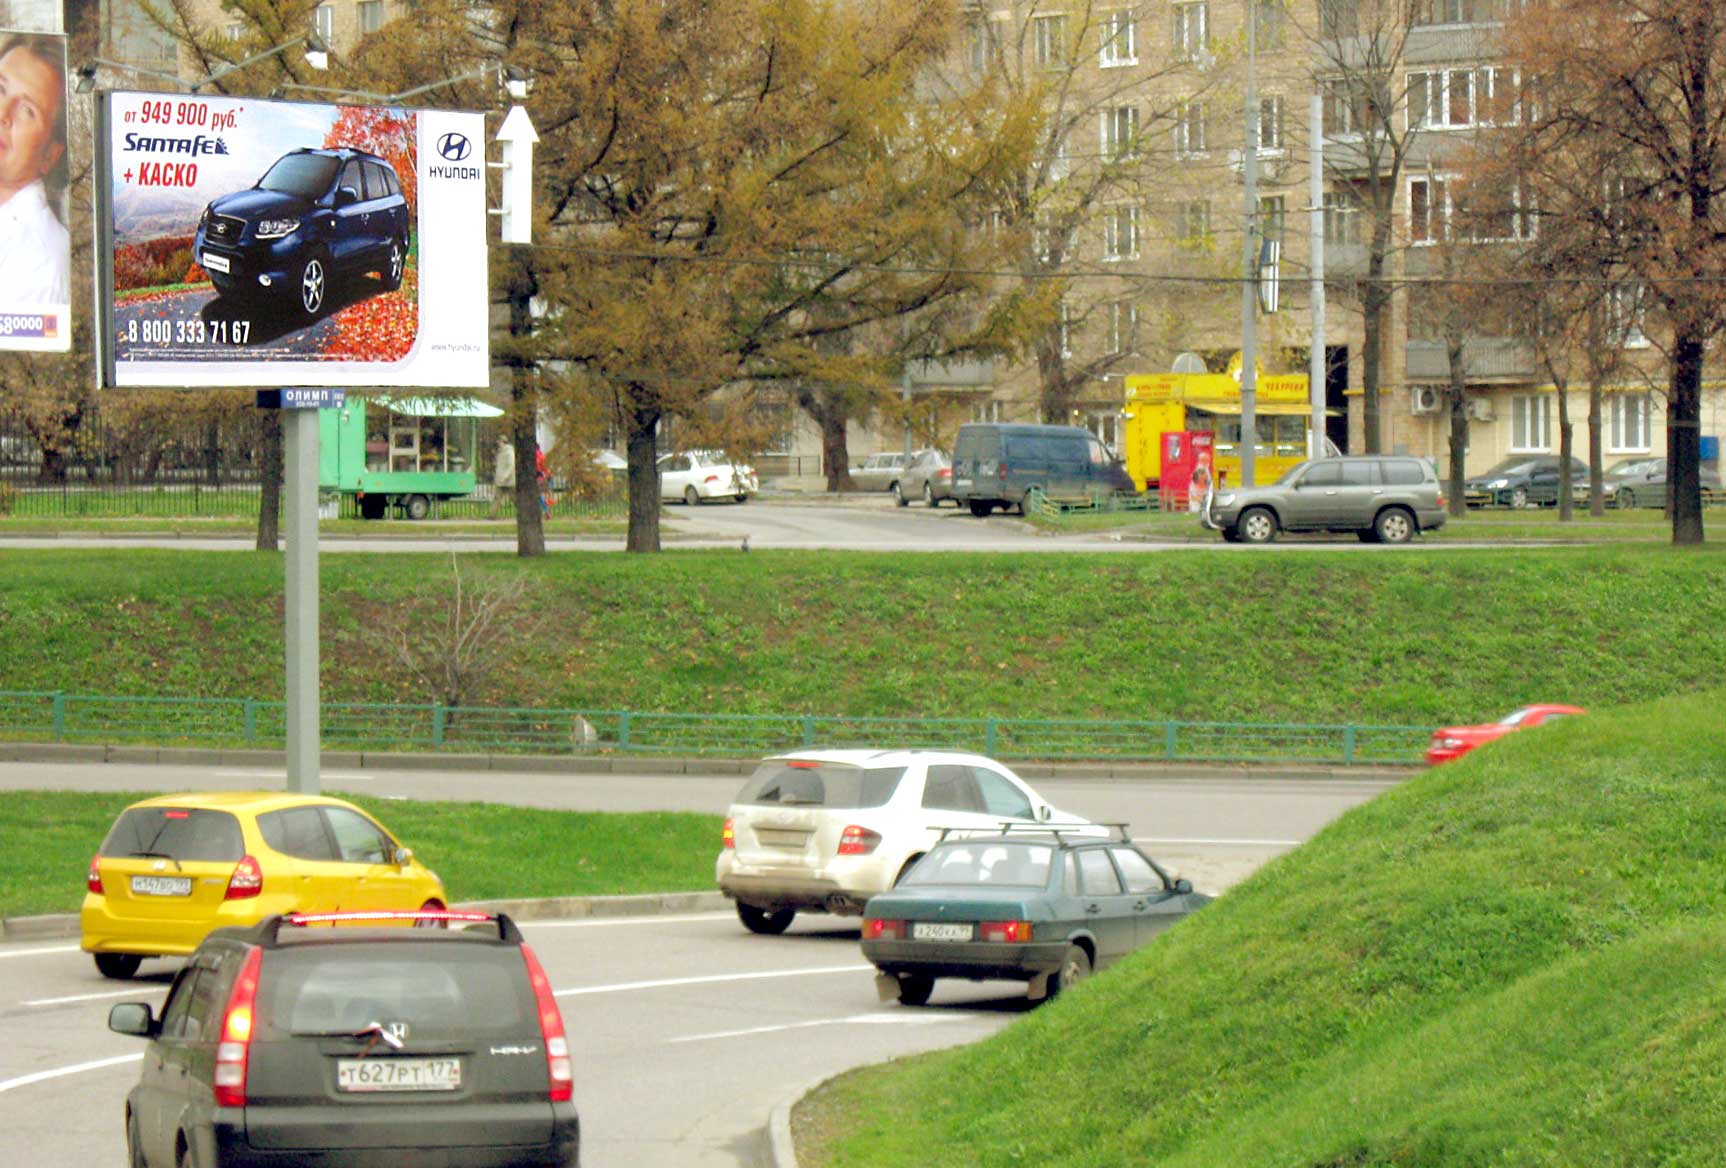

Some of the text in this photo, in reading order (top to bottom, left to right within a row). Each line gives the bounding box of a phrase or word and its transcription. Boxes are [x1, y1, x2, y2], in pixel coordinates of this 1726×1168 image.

[124, 111, 137, 123] от
[141, 100, 172, 124] 949
[176, 102, 208, 126] 900
[138, 161, 198, 188] КАСКО
[429, 165, 480, 180] HYUNDAI
[128, 319, 250, 344] 8 800 333 71 67
[286, 390, 329, 401] ОЛИМП
